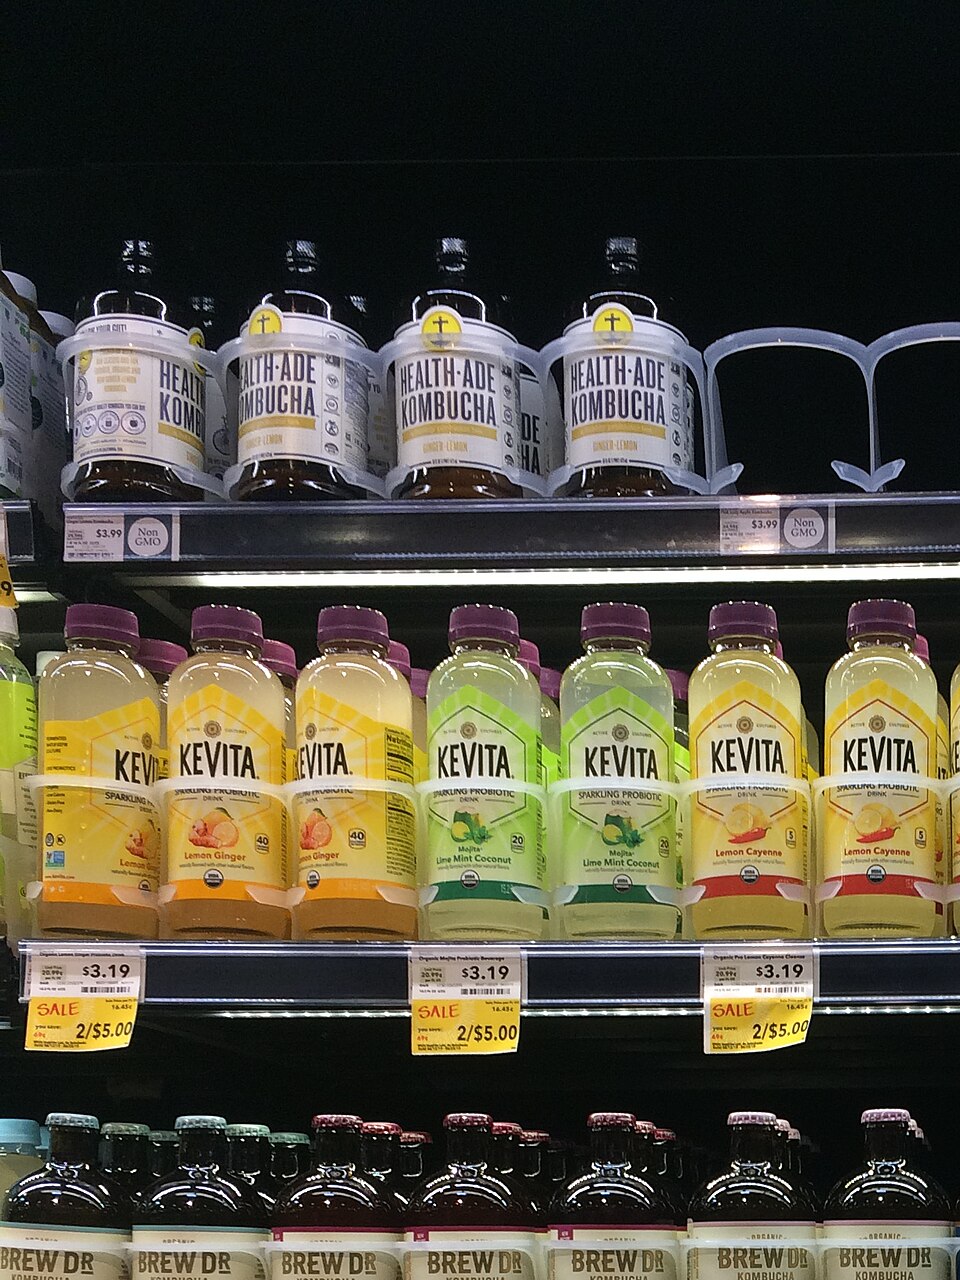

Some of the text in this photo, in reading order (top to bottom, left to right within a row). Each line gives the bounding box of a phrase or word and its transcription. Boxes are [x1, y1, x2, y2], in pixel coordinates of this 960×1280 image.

[401, 391, 498, 426] KOMBUCHA
[571, 389, 666, 425] KOMBUCHA
[752, 520, 777, 529] $3.99
[794, 519, 814, 527] Non
[96, 530, 122, 538] $3.99
[138, 528, 158, 536] Non
[791, 528, 817, 536] GMO
[135, 538, 161, 546] GMO
[184, 852, 246, 863] Lemon Ginger
[715, 848, 782, 858] Lemon Cayenne
[436, 856, 451, 864] Lime
[473, 856, 511, 865] Coconut
[82, 964, 130, 979] $3.19
[461, 966, 509, 980] $3.19
[37, 1002, 79, 1017] SALE
[418, 1004, 459, 1019] SALE
[76, 1021, 133, 1039] 2/$5.00
[458, 1025, 517, 1041] 2/$5.00
[138, 1251, 197, 1274] BREW
[282, 1251, 341, 1274] BREW
[737, 1271, 794, 1280] KOMBUCHA
